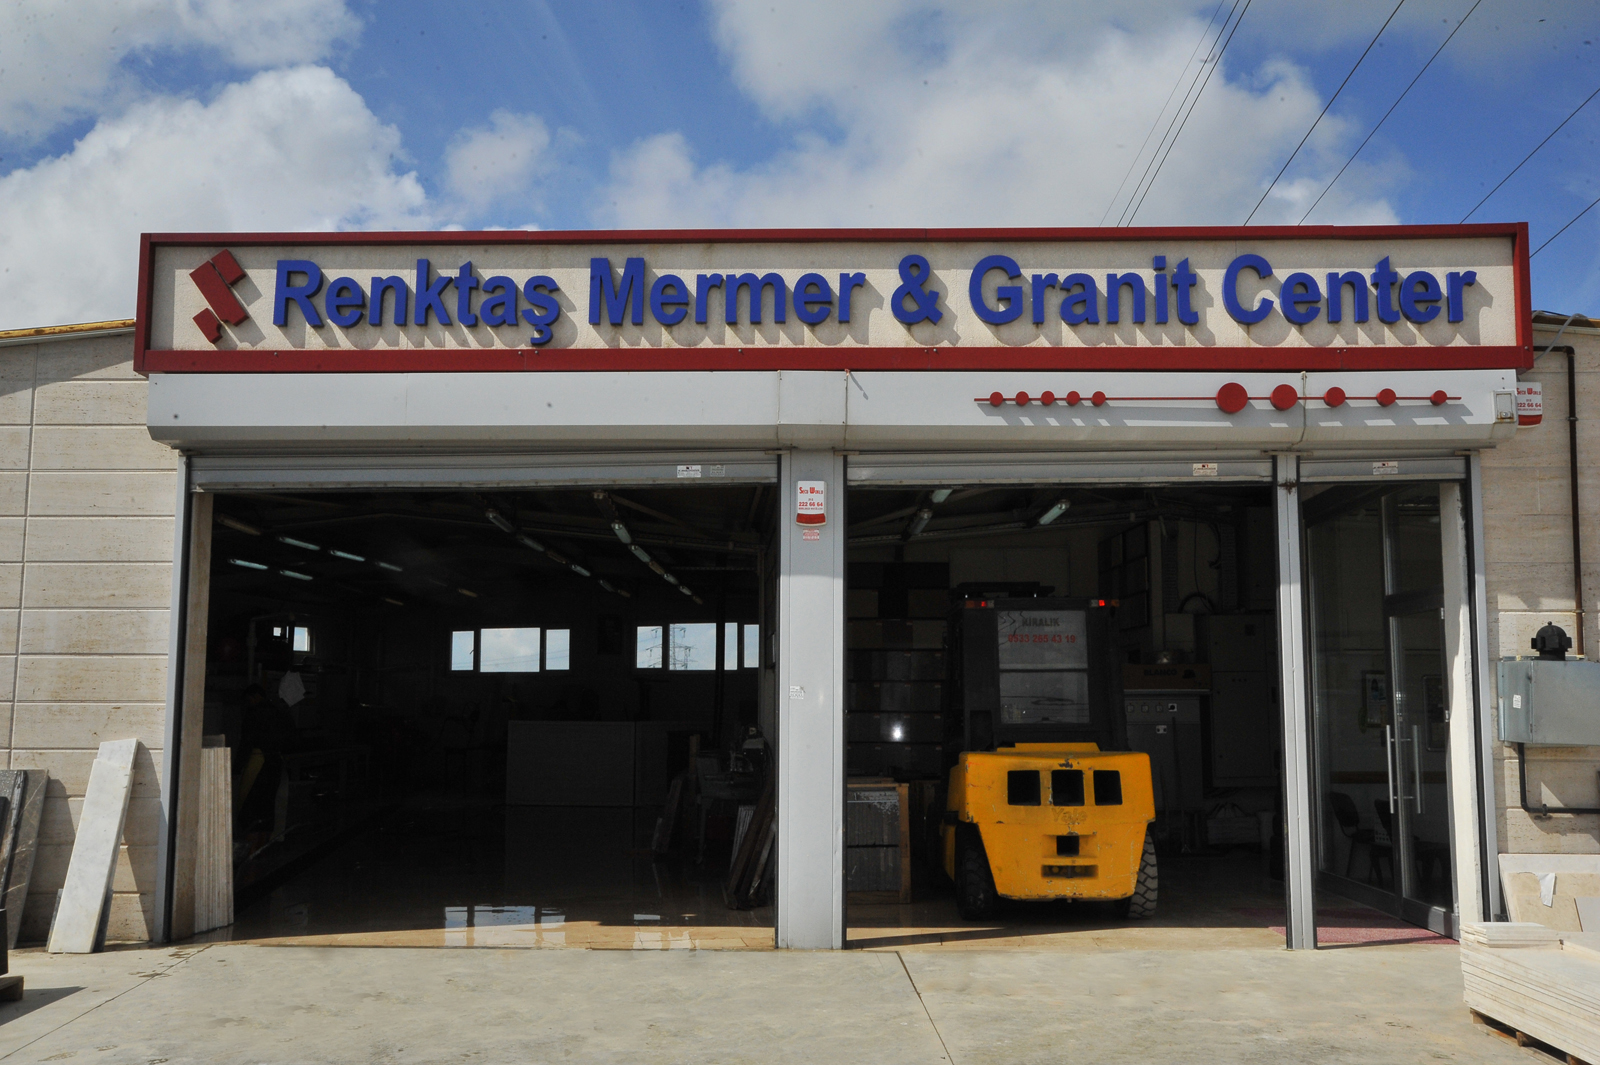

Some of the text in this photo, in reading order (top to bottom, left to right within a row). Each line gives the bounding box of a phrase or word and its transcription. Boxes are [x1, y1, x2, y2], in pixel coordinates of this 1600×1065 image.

[273, 253, 1477, 346] Renktaş Mermer & Granit Center
[1051, 633, 1062, 644] 43
[1065, 633, 1076, 644] 19
[1143, 668, 1178, 677] BLANCO
[1051, 807, 1088, 823] Yale
